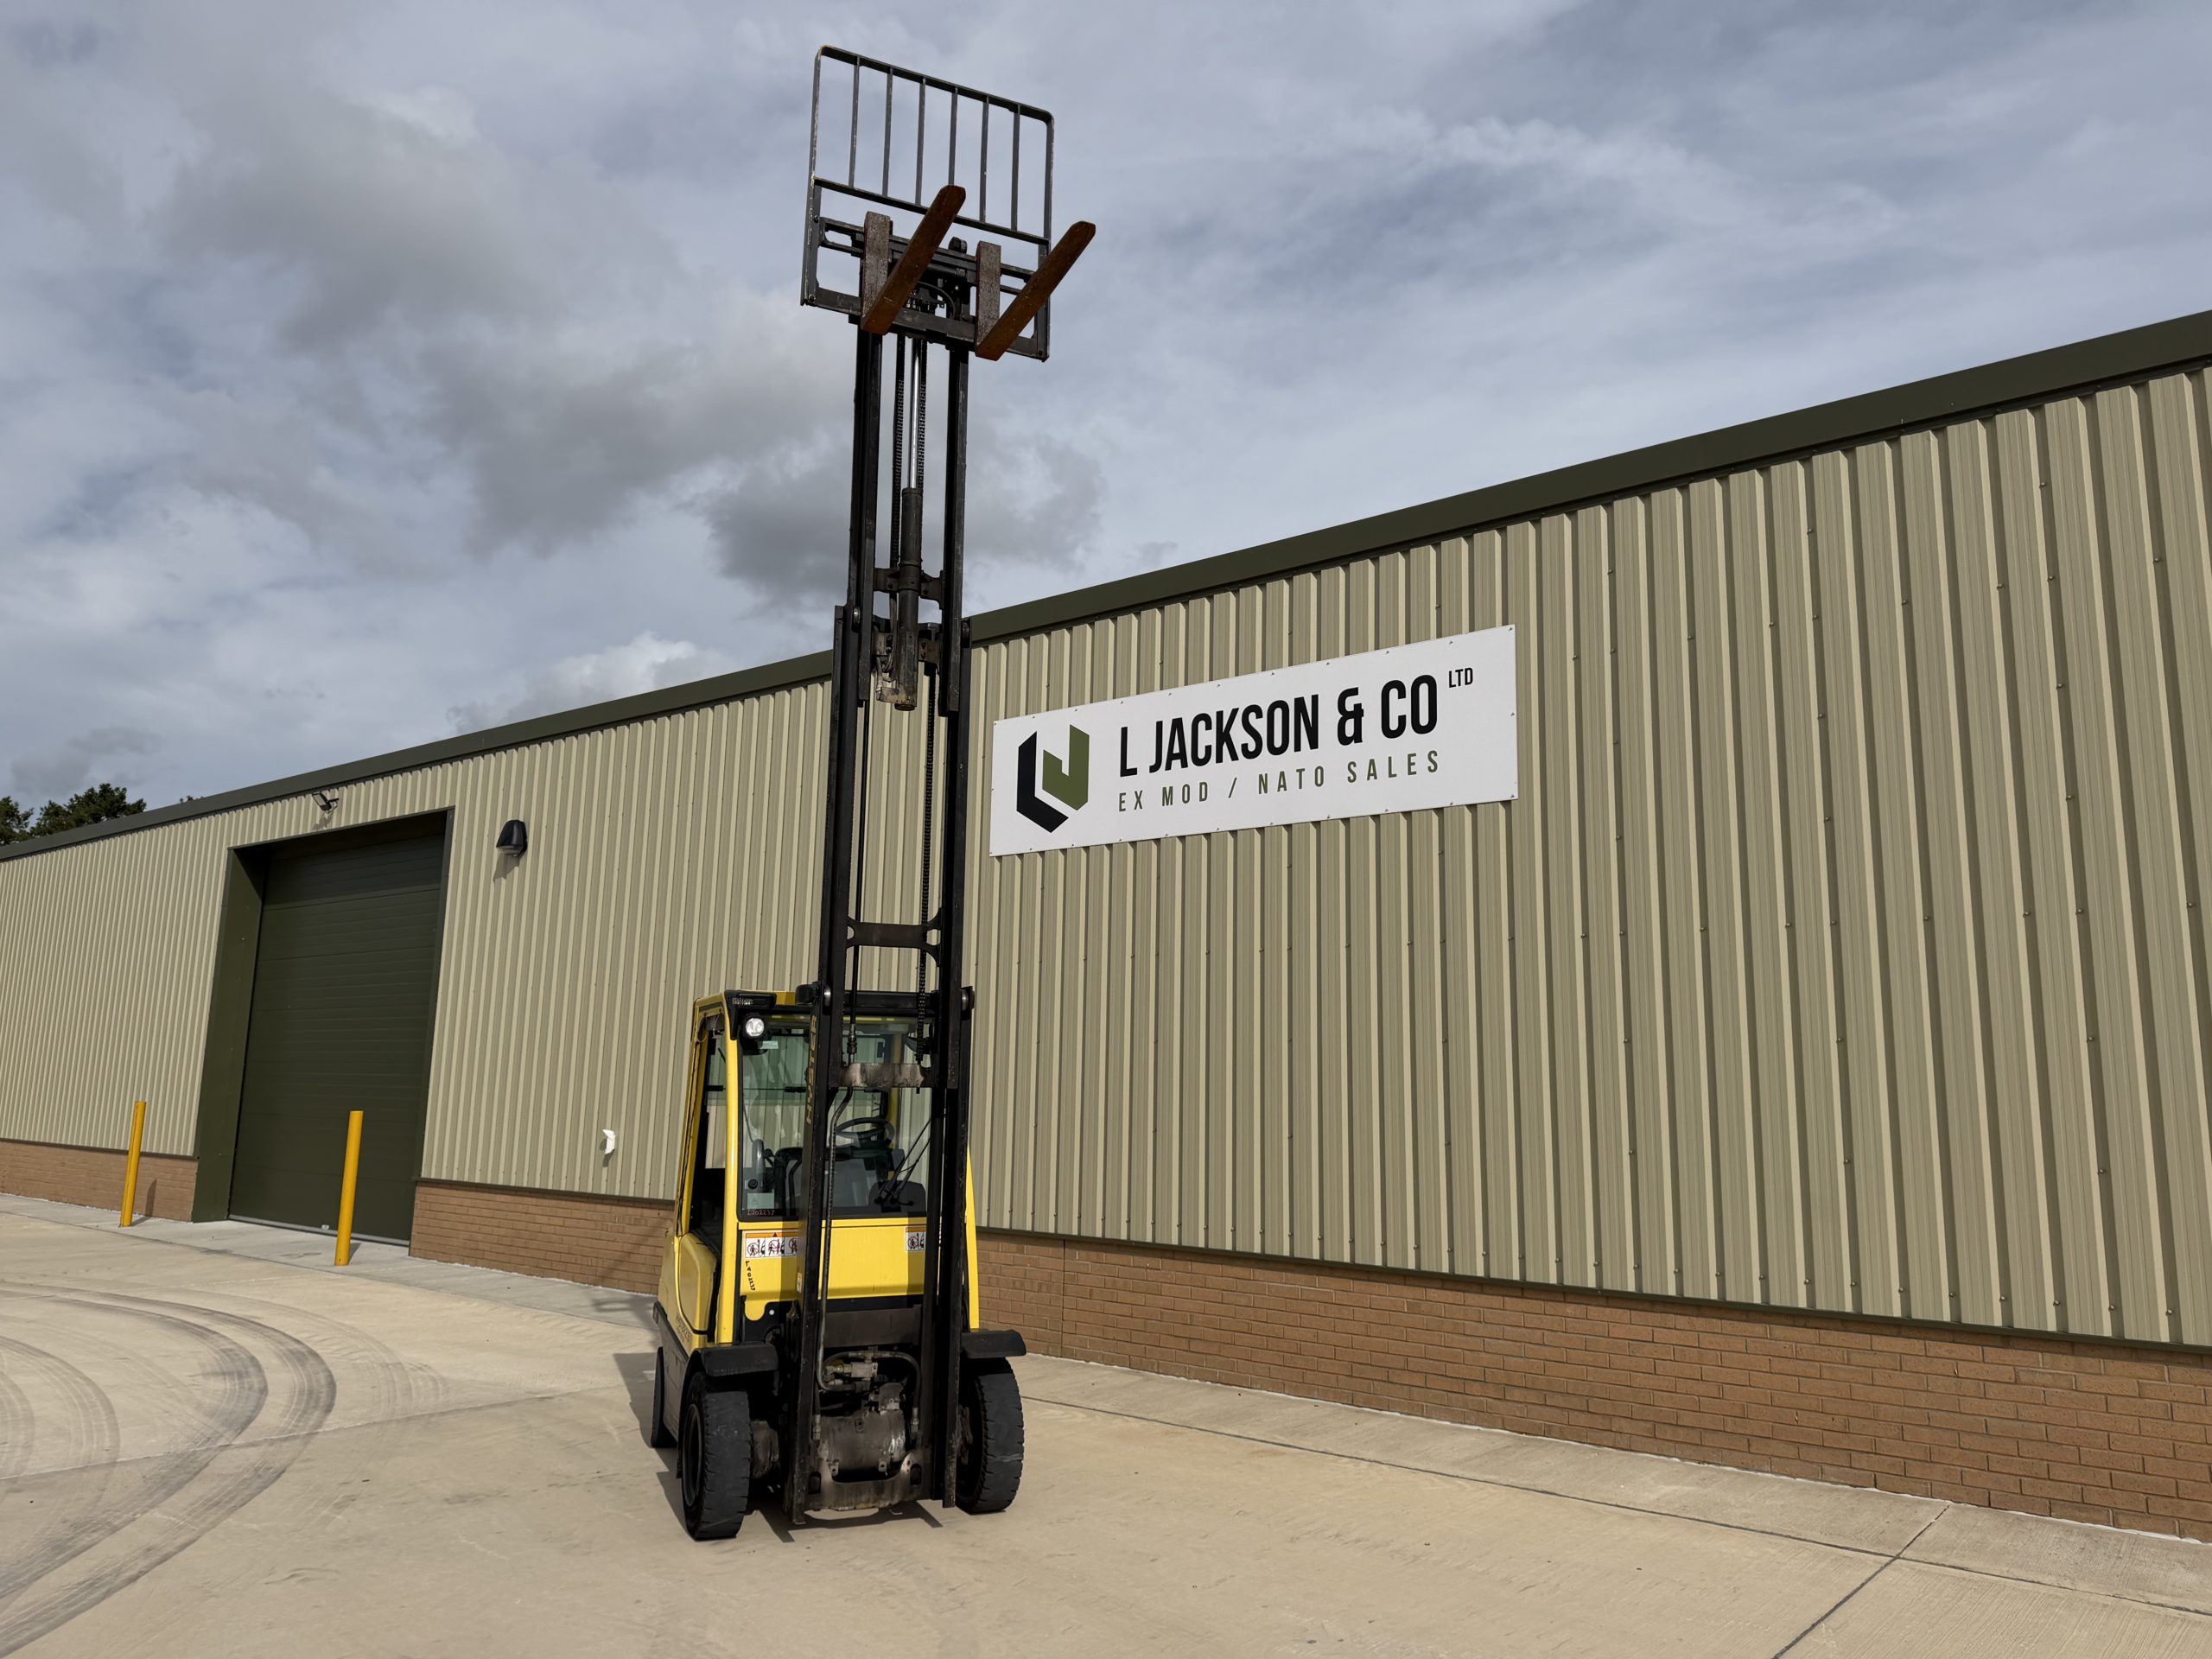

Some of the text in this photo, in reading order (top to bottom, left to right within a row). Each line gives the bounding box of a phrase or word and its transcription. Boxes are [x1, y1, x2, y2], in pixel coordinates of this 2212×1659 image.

[1120, 667, 1474, 777] L JACKSON & CO LTD
[1119, 790, 1143, 812] EX
[1161, 781, 1208, 807] MOD
[1258, 766, 1325, 794] NATO
[1347, 750, 1439, 784] SALES
[805, 1014, 817, 1124] HYSTER
